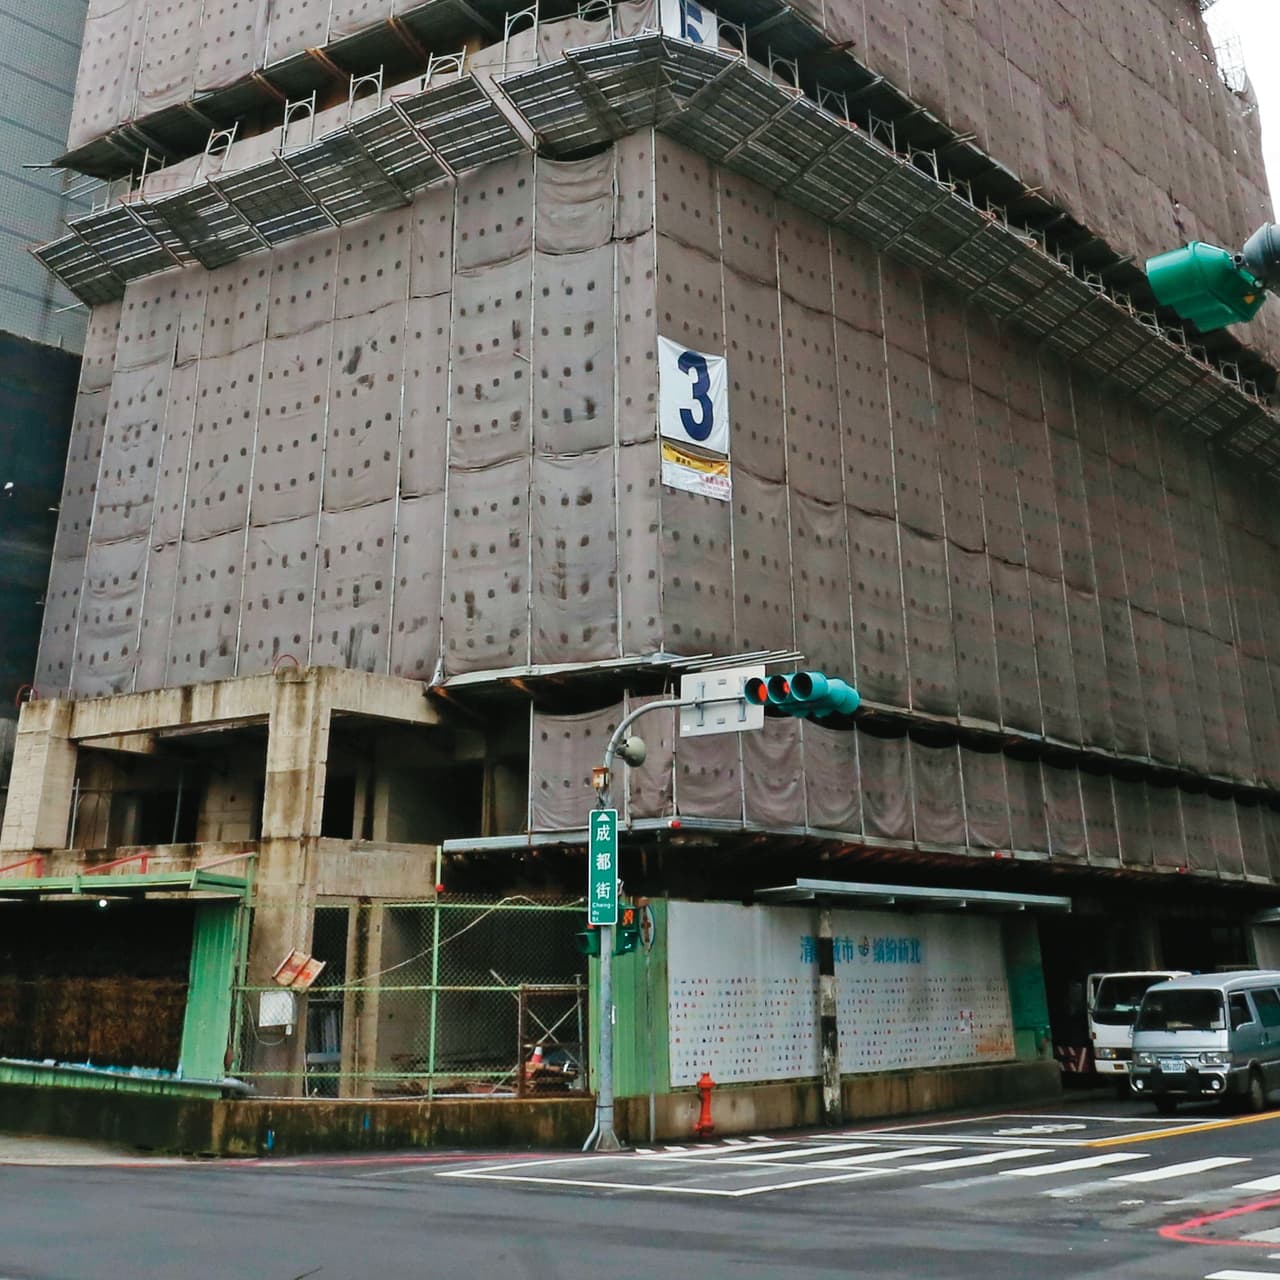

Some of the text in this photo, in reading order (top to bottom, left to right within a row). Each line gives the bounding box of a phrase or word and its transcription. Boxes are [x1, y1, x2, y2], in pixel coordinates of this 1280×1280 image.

[678, 351, 713, 441] 3
[596, 824, 611, 899] 成都街
[800, 936, 853, 963] 清城市
